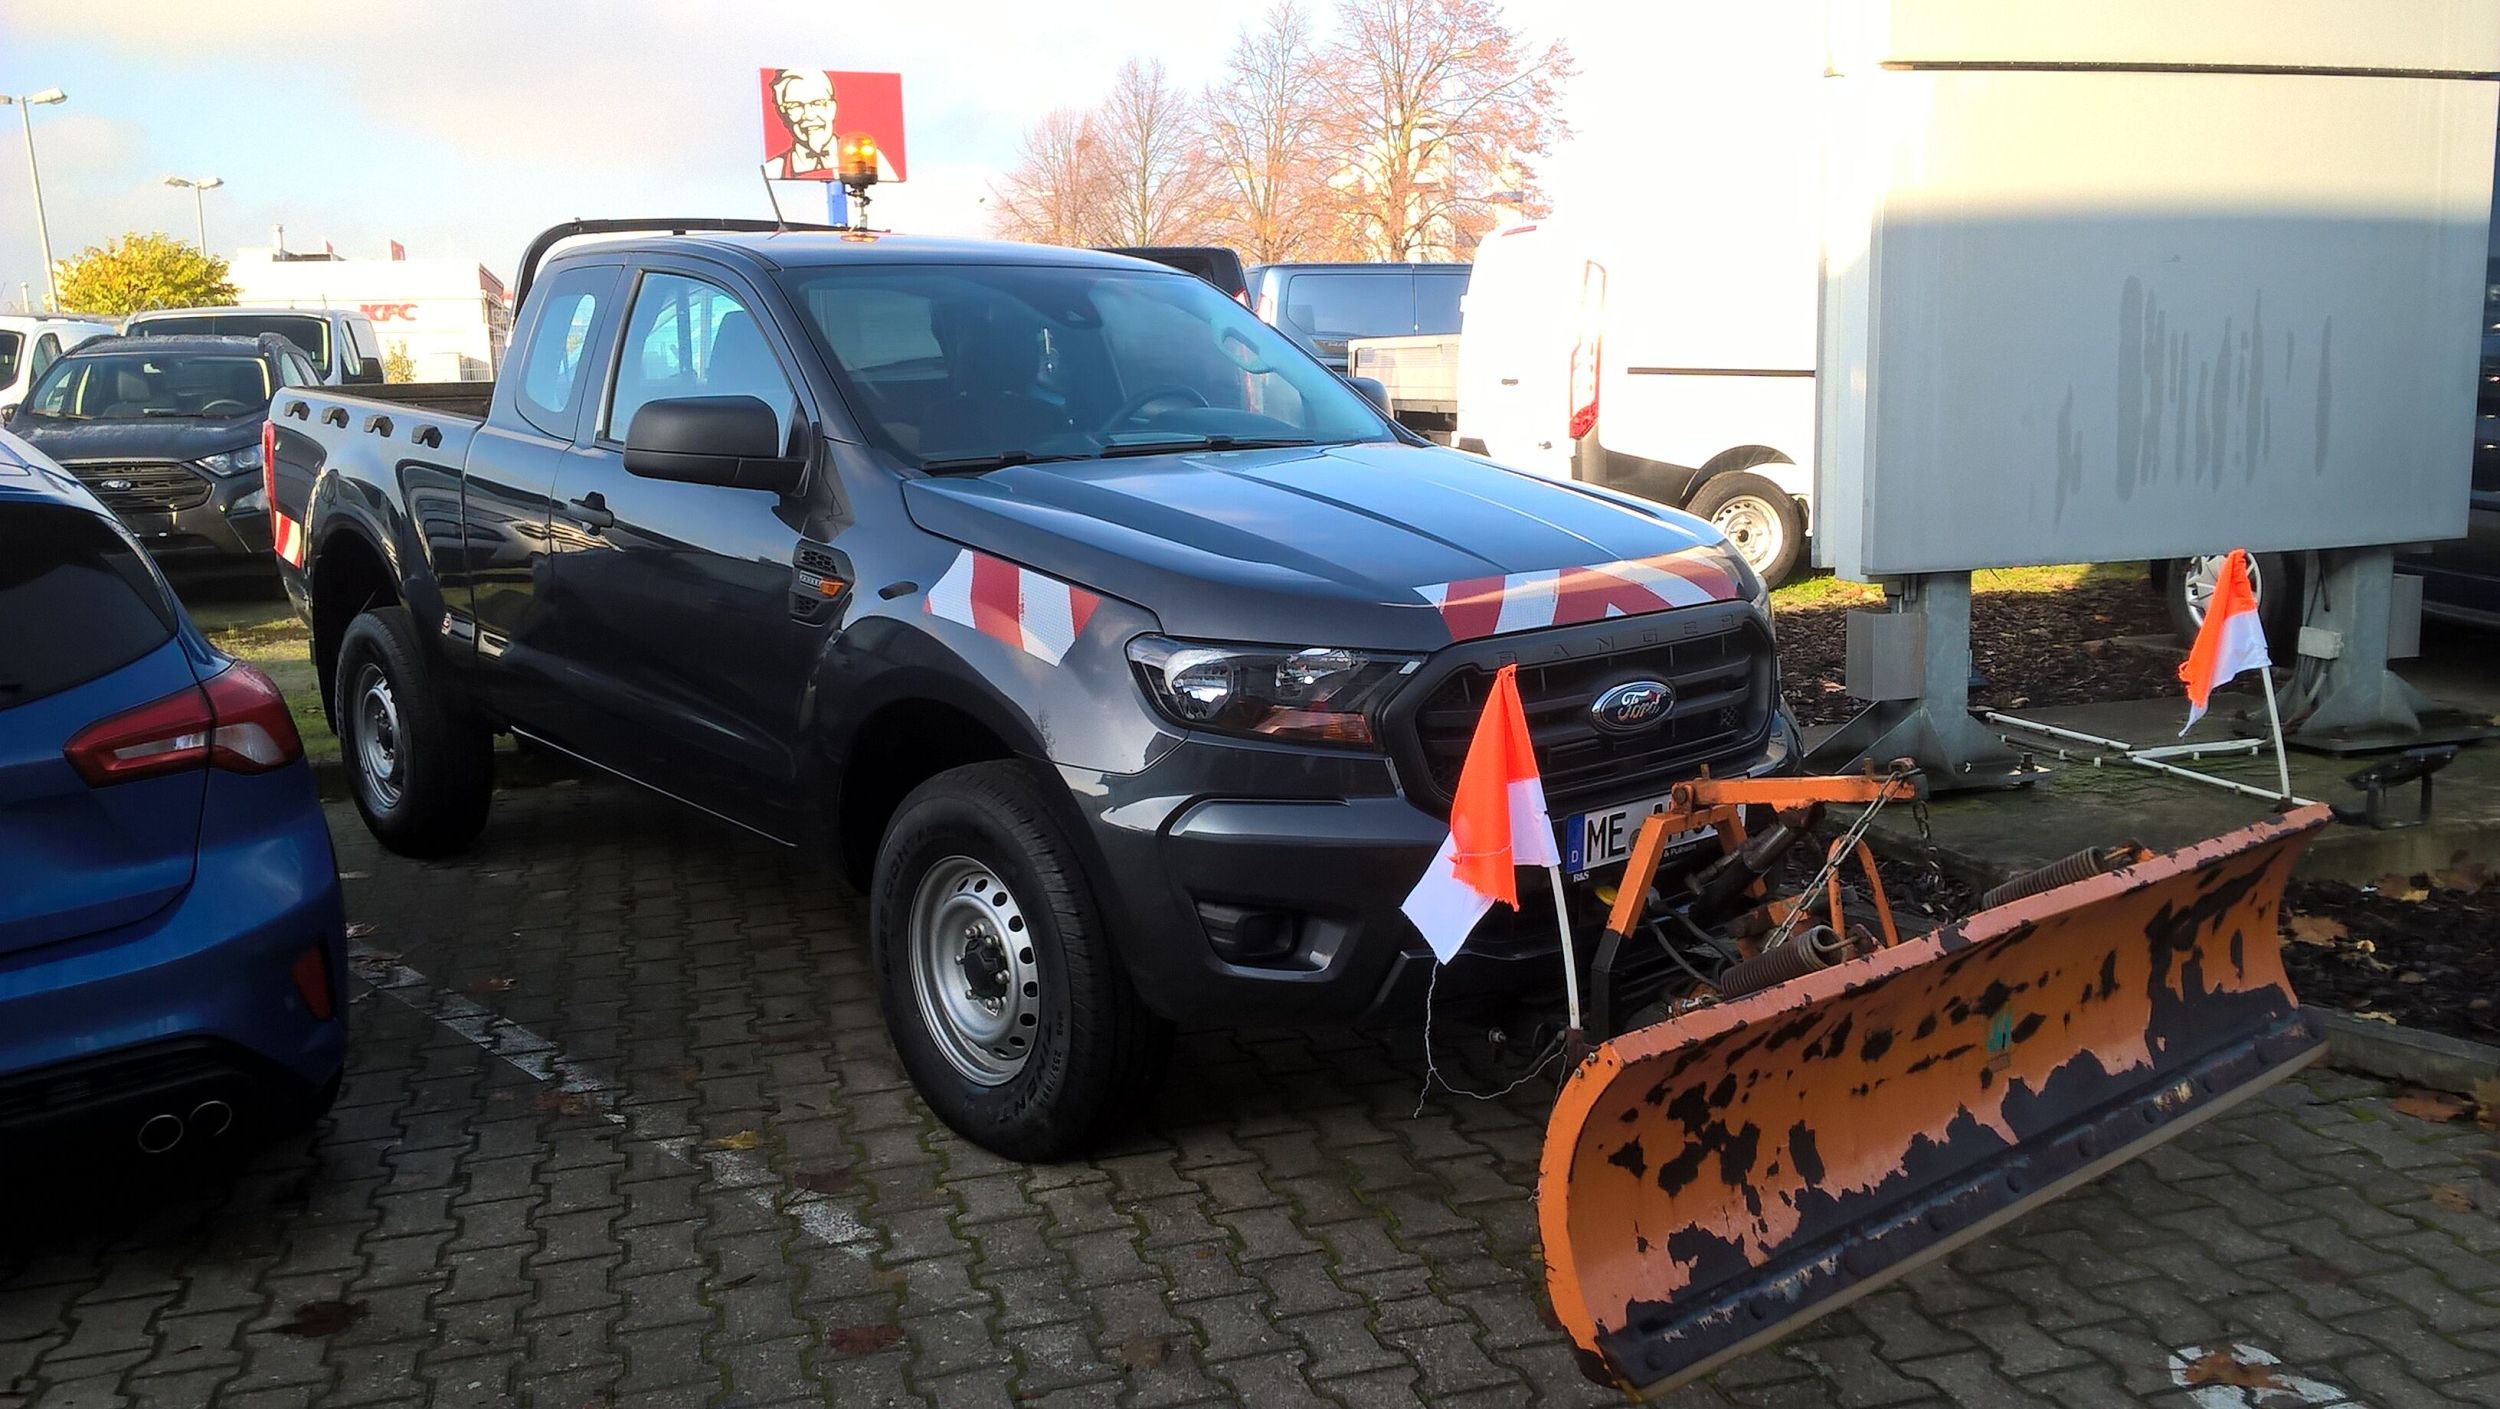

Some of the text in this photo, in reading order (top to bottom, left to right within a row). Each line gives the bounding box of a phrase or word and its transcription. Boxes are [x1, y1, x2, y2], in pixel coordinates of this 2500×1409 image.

[359, 303, 418, 321] KFC
[1617, 689, 1661, 721] Ford
[1586, 811, 1627, 863] ME
[1571, 850, 1579, 863] D
